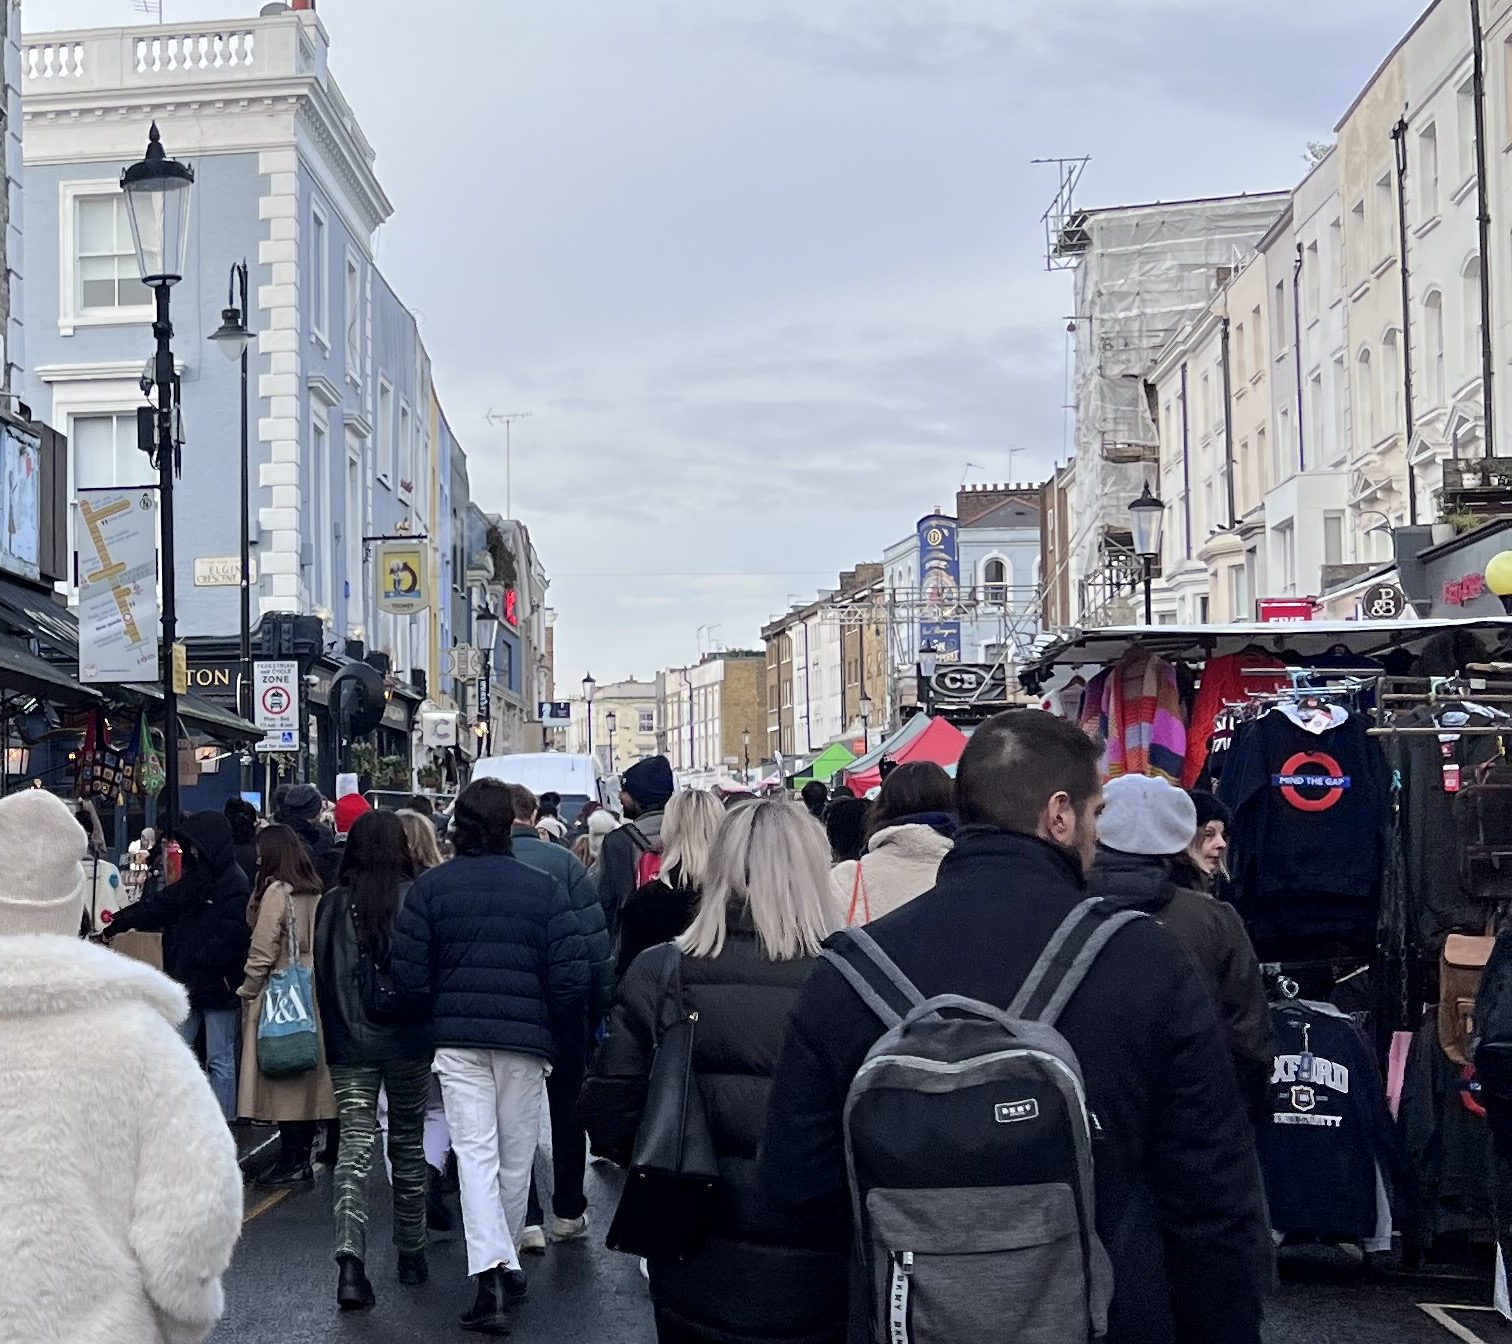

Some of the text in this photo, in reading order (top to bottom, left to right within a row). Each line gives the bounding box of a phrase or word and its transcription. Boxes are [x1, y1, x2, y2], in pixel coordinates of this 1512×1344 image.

[1379, 589, 1395, 603] P
[262, 675, 289, 684] ZONE
[944, 673, 977, 689] CB
[1279, 776, 1344, 786] MIND THE GAP
[265, 985, 308, 1024] V&A
